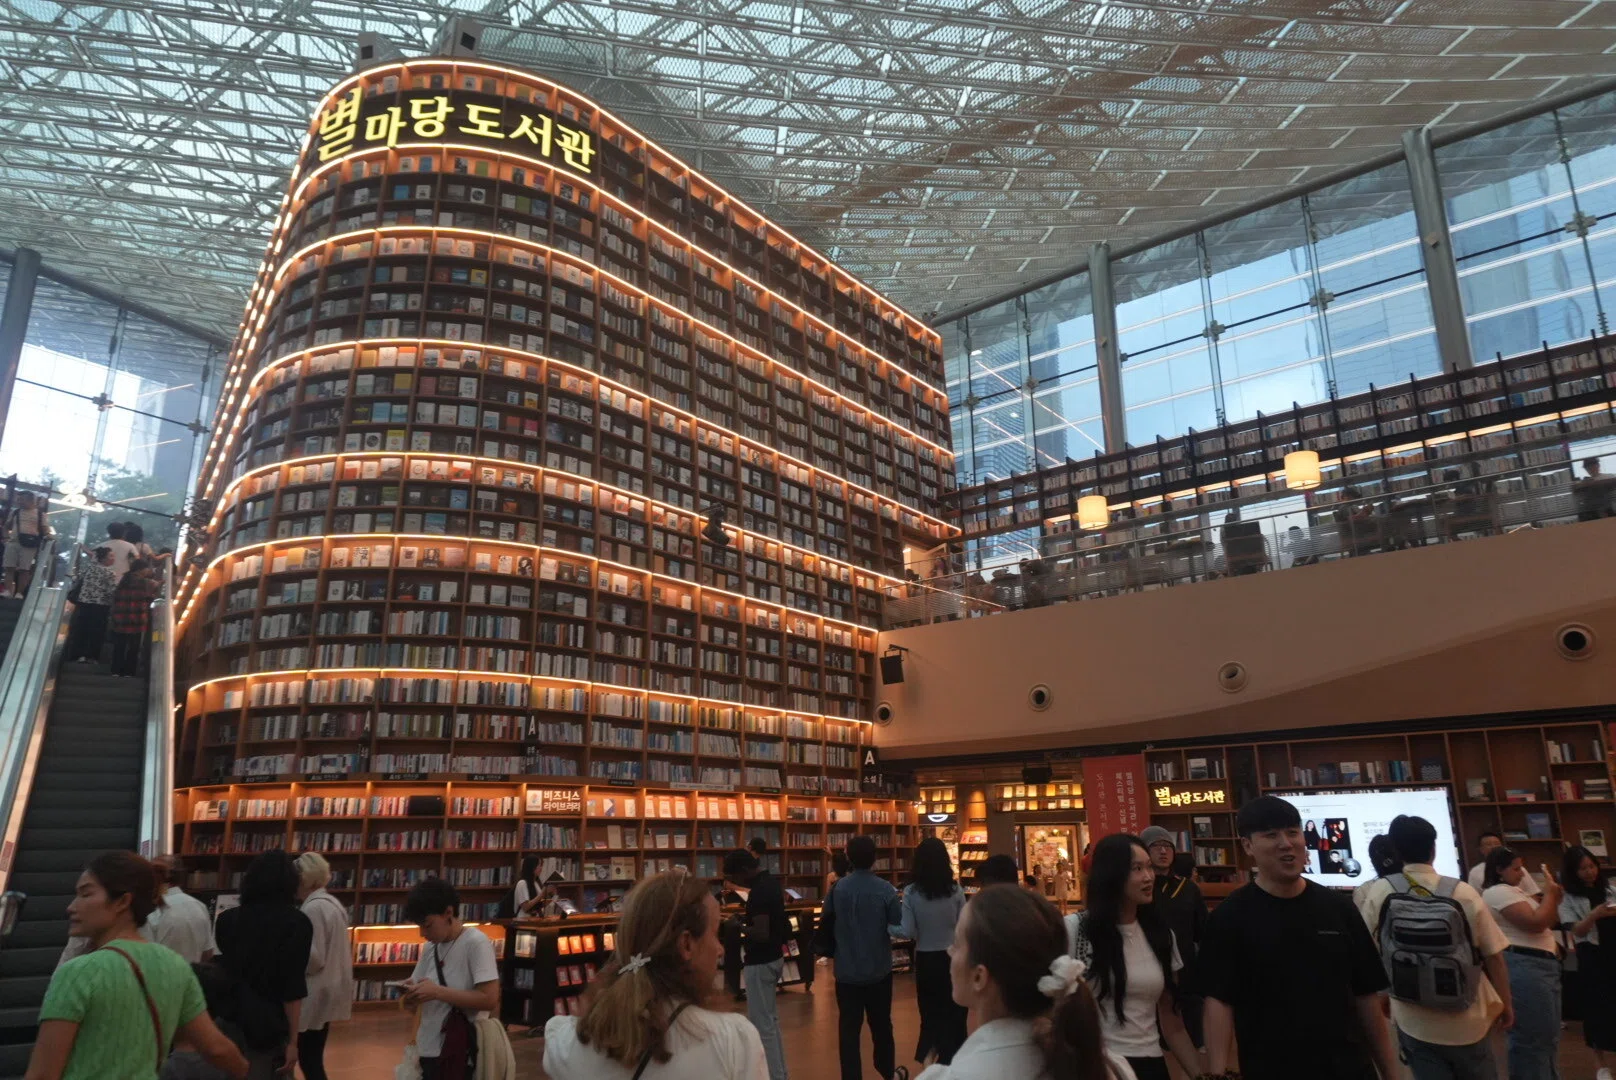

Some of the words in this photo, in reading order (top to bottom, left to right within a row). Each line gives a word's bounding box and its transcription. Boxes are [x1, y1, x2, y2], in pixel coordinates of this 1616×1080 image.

[318, 87, 455, 161] 별마당
[458, 103, 596, 174] 도서관
[528, 715, 536, 735] A
[864, 750, 875, 765] A
[543, 790, 581, 802] 비즈니스
[1154, 786, 1192, 807] 별마당
[1192, 790, 1225, 804] 도서관
[543, 801, 581, 812] 라이브러리
